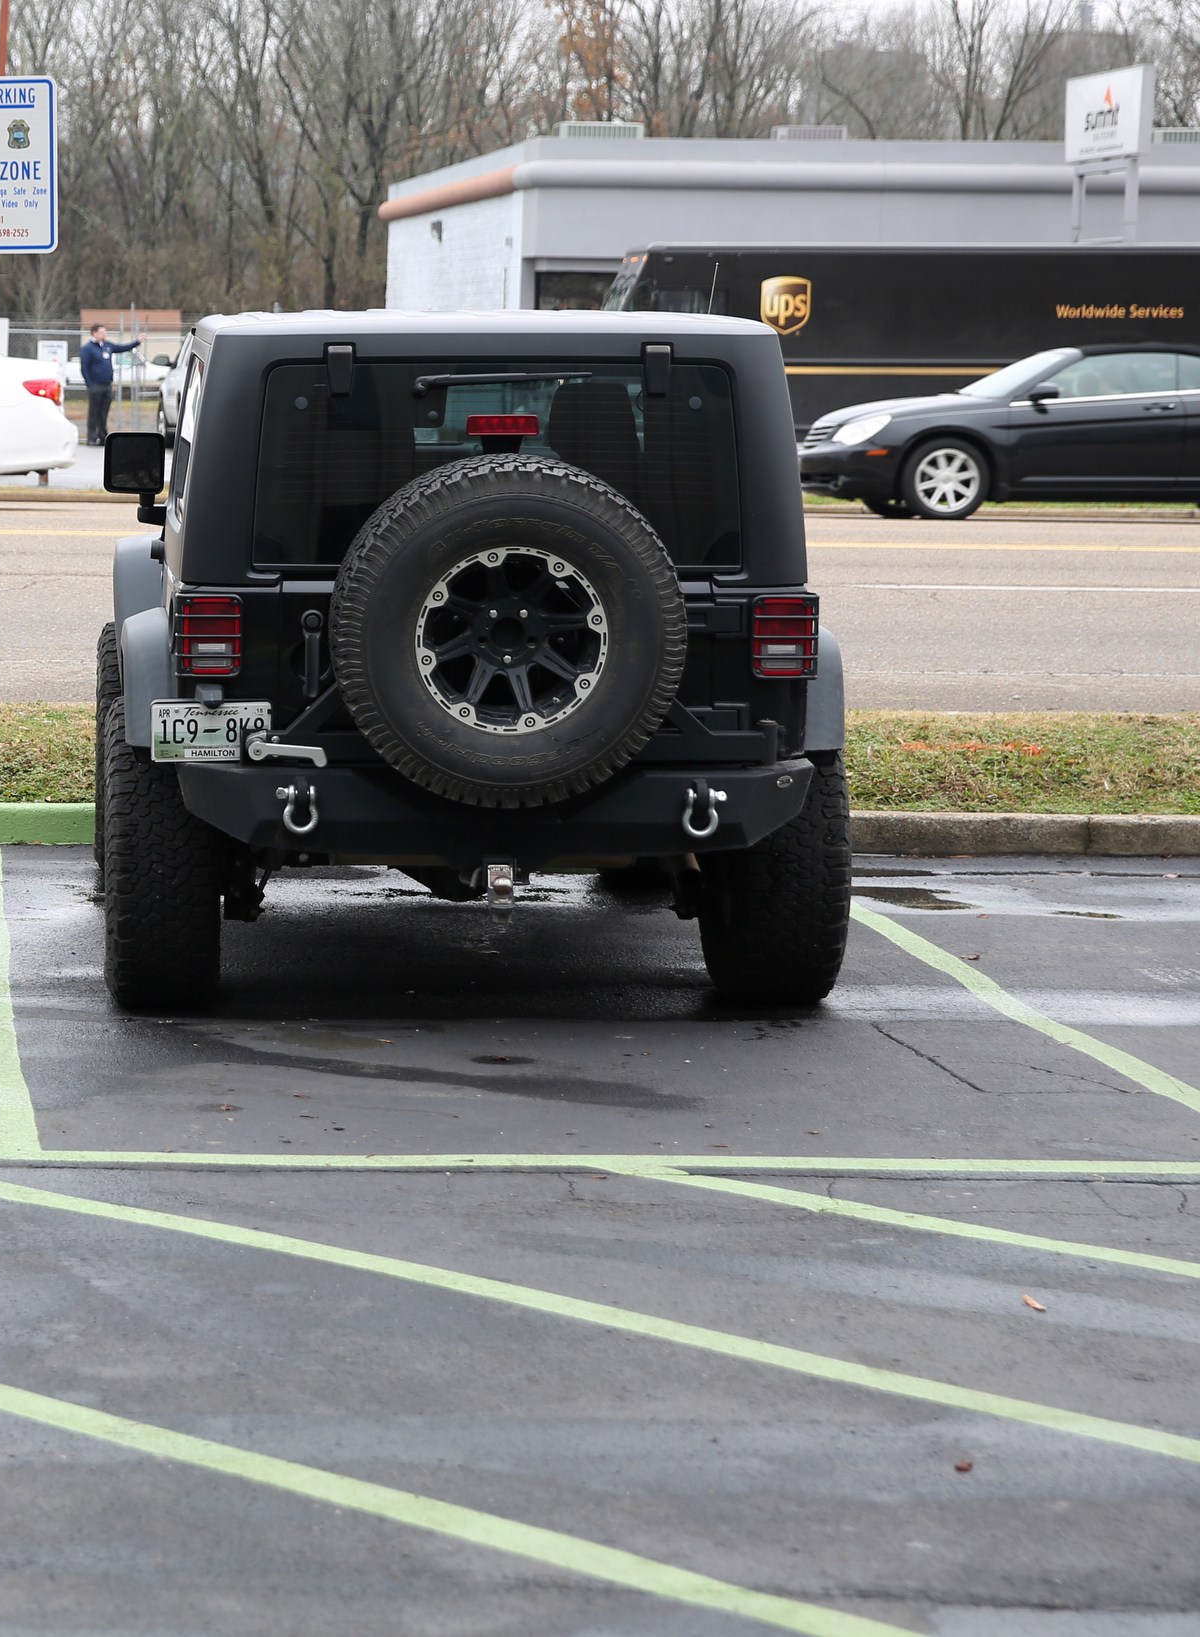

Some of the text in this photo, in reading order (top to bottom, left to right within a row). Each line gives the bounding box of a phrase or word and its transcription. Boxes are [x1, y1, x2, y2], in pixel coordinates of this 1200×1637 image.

[0, 160, 42, 181] ZONE
[13, 186, 26, 196] Safe
[32, 186, 47, 195] Zone
[2, 199, 18, 208] Video
[24, 199, 39, 209] Only
[764, 293, 807, 326] ups
[1056, 303, 1185, 320] Worldwide Services
[158, 709, 171, 718] APR
[183, 707, 239, 718] Tennessee
[191, 749, 235, 757] HAMILTON
